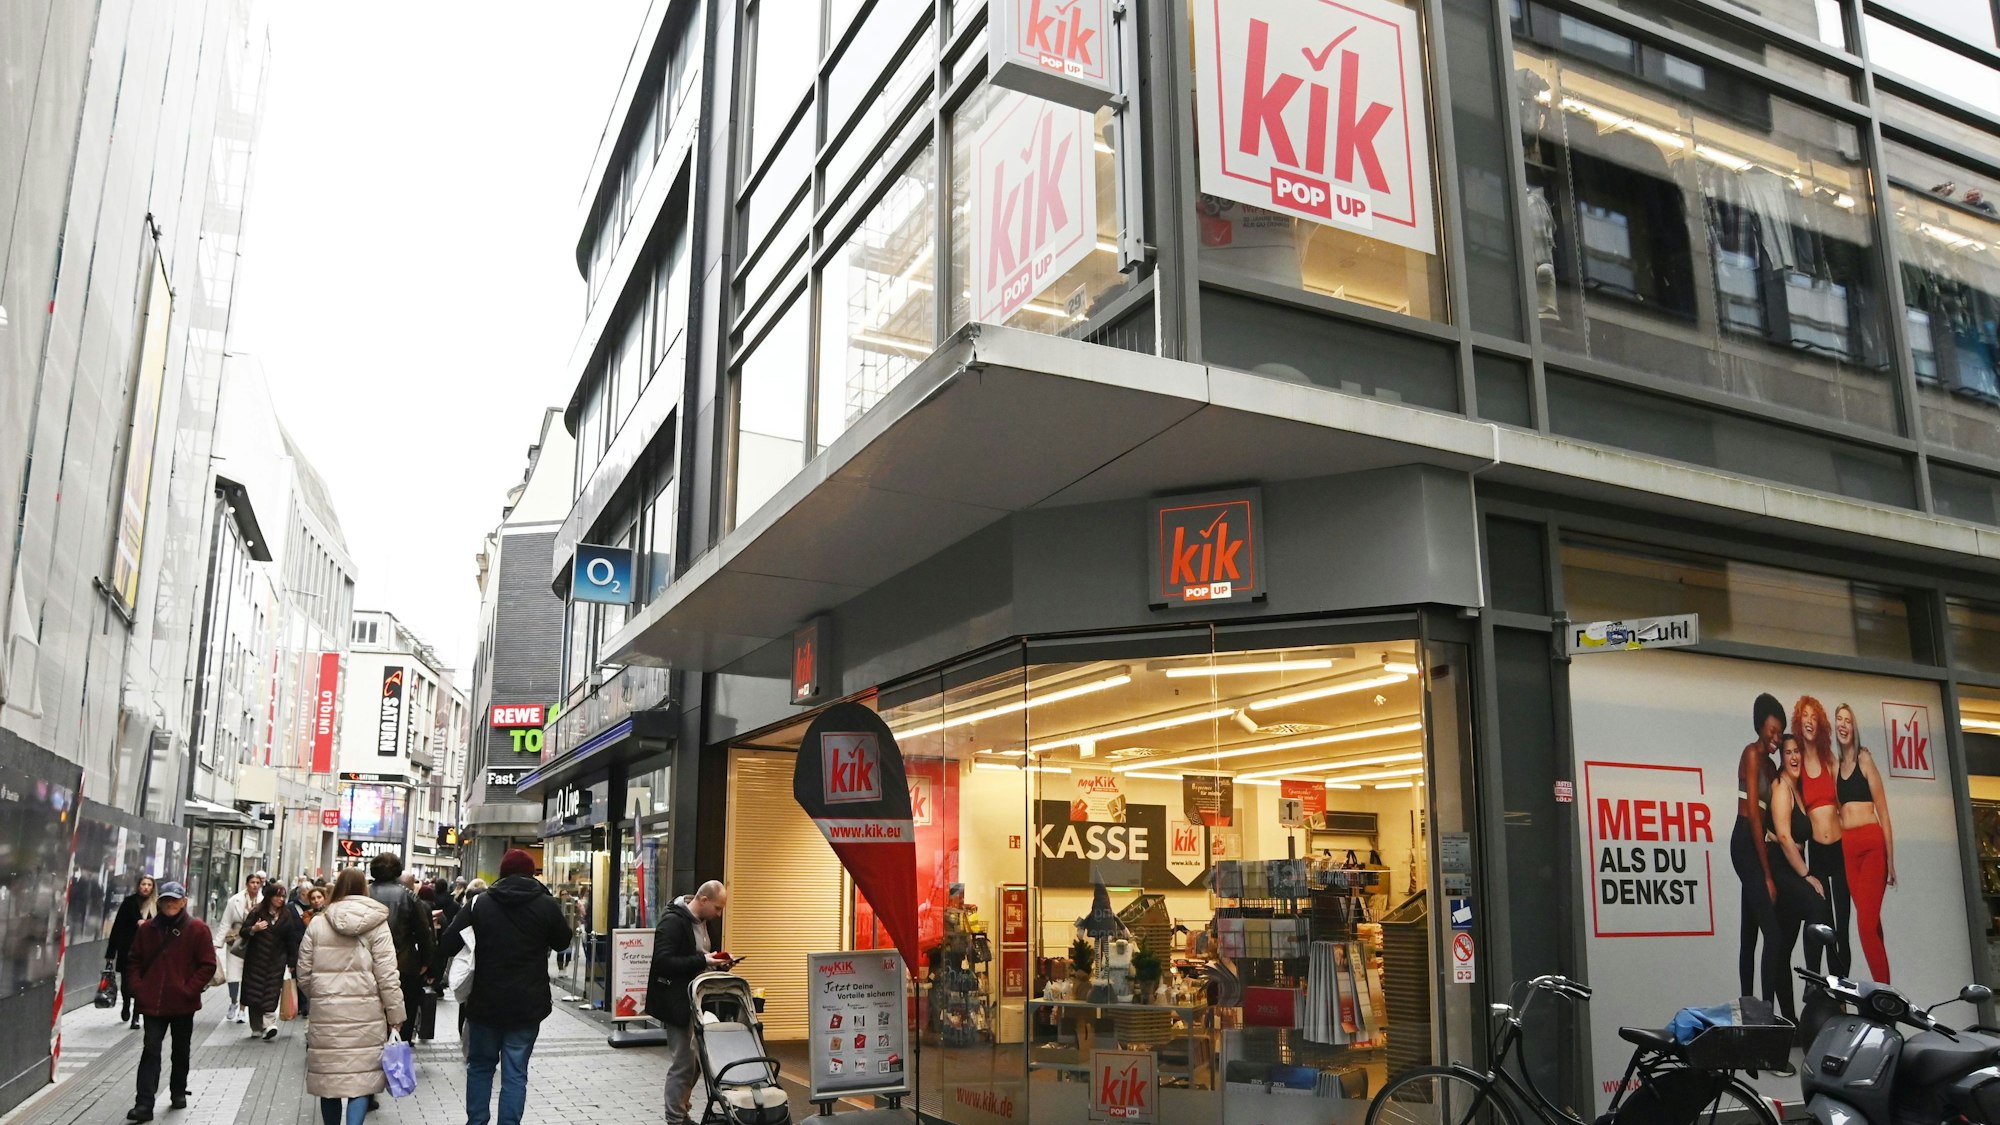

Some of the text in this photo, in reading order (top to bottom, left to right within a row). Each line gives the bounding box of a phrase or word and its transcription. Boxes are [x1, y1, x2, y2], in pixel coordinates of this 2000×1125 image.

[1026, 0, 1096, 66] kik
[1040, 55, 1081, 74] POP UP
[1239, 17, 1394, 195] kik
[987, 110, 1073, 293] kik
[1276, 177, 1366, 217] POP UP
[1003, 253, 1053, 307] POP UP
[1169, 522, 1244, 584] kik
[1186, 586, 1228, 598] POP UP
[318, 690, 333, 735] UNIQLO
[380, 696, 400, 752] SATURN
[493, 707, 540, 724] REWE
[432, 727, 447, 776] SATURN
[510, 729, 543, 753] TO
[1891, 719, 1929, 770] kik
[487, 772, 517, 785] Fast.
[831, 748, 874, 793] kik
[565, 783, 580, 818] Live
[829, 823, 902, 838] www.kik.eu
[1597, 798, 1714, 843] MEHR
[361, 842, 402, 857] SATURN
[1034, 823, 1149, 861] KASSE
[1174, 829, 1198, 852] kik
[1600, 847, 1686, 873] ALS DU
[1601, 879, 1698, 905] DENKST
[883, 960, 895, 970] kik
[823, 981, 852, 994] Jetzt
[837, 992, 865, 1000] Vorteile
[956, 1086, 1014, 1119] www.kik.de
[1100, 1066, 1148, 1107] kik
[1127, 1108, 1138, 1116] UP
